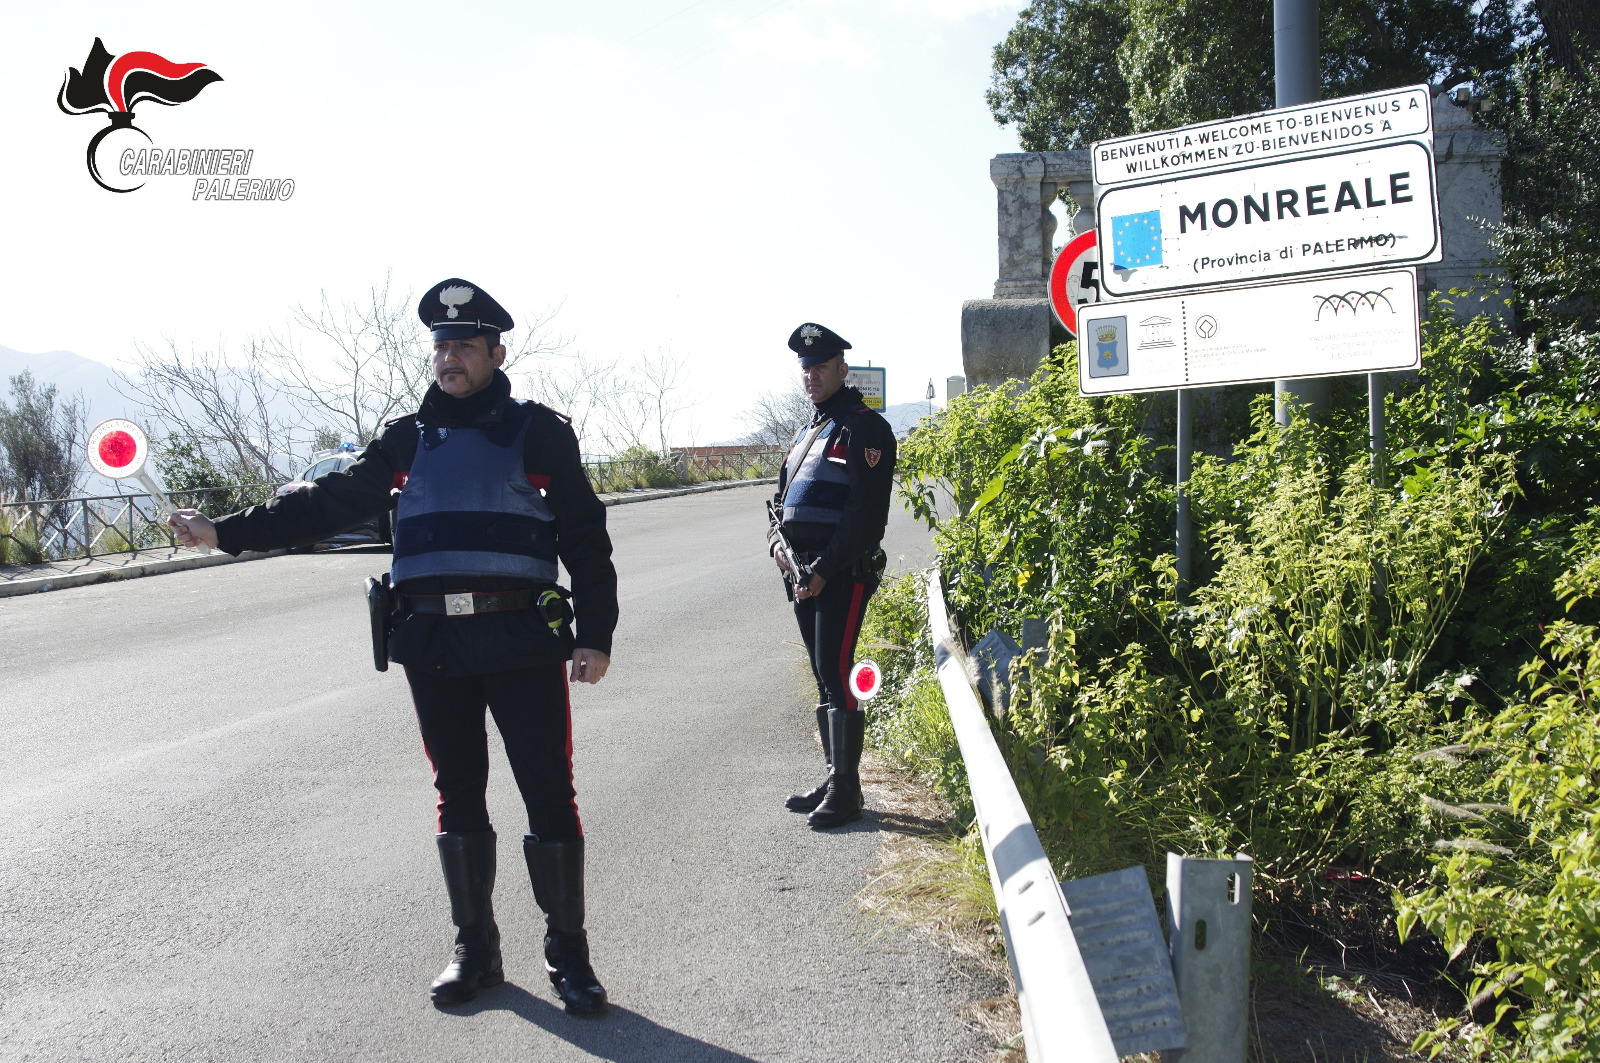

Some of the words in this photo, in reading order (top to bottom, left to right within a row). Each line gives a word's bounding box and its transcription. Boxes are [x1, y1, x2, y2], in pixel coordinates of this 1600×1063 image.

[1101, 137, 1180, 162] BENVENUTI
[1408, 97, 1420, 110] A
[1126, 147, 1229, 174] WILLKOMMEN
[1381, 119, 1393, 133] A
[1179, 171, 1414, 234] MONREALE
[1193, 249, 1272, 274] (Provincia
[1279, 245, 1294, 260] di
[1302, 232, 1397, 257] PALERMO)
